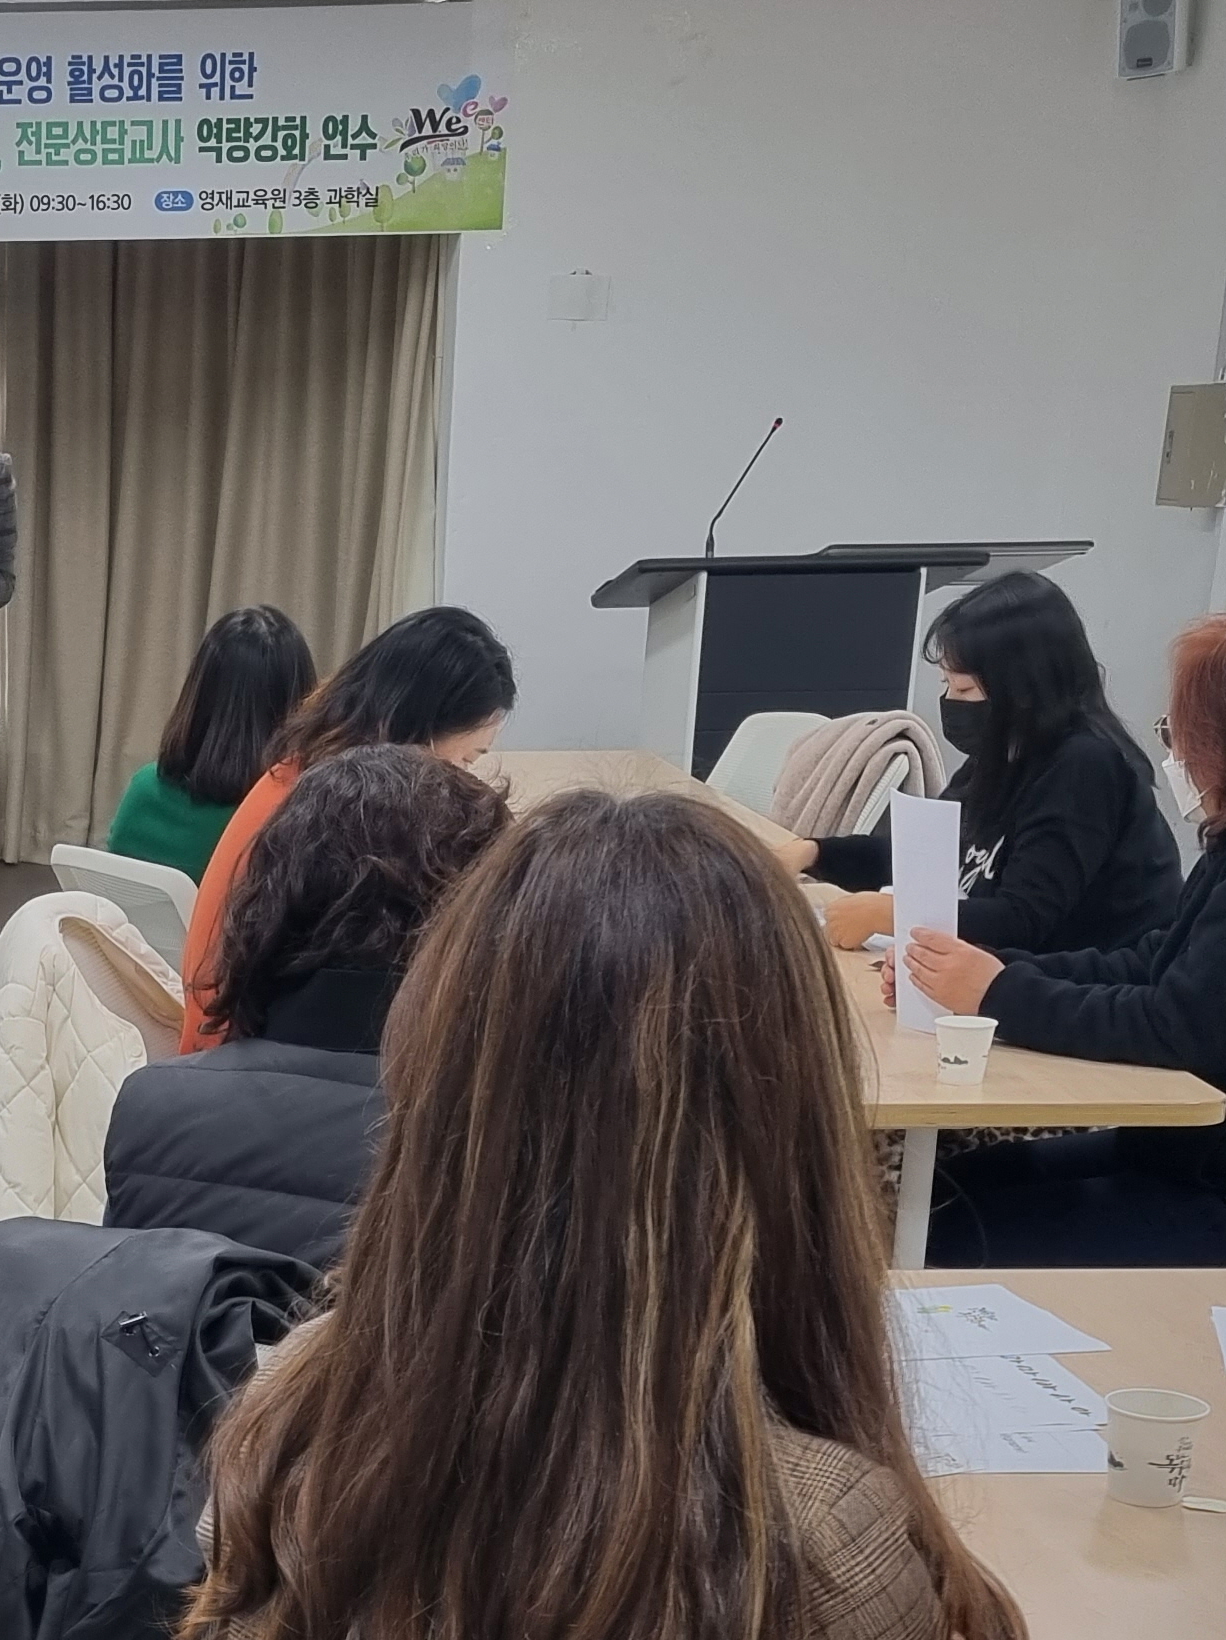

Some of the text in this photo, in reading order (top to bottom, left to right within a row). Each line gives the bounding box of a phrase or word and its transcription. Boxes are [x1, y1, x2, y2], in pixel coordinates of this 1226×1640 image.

[67, 53, 184, 103] 활성화를
[198, 51, 258, 101] 위한
[15, 118, 184, 167] 전문상담교사
[196, 115, 309, 163] 역량강화
[321, 114, 378, 162] 연수
[29, 193, 132, 212] 09:30~16:30
[160, 186, 380, 211] 장소 영재교육원 3층 과학실
